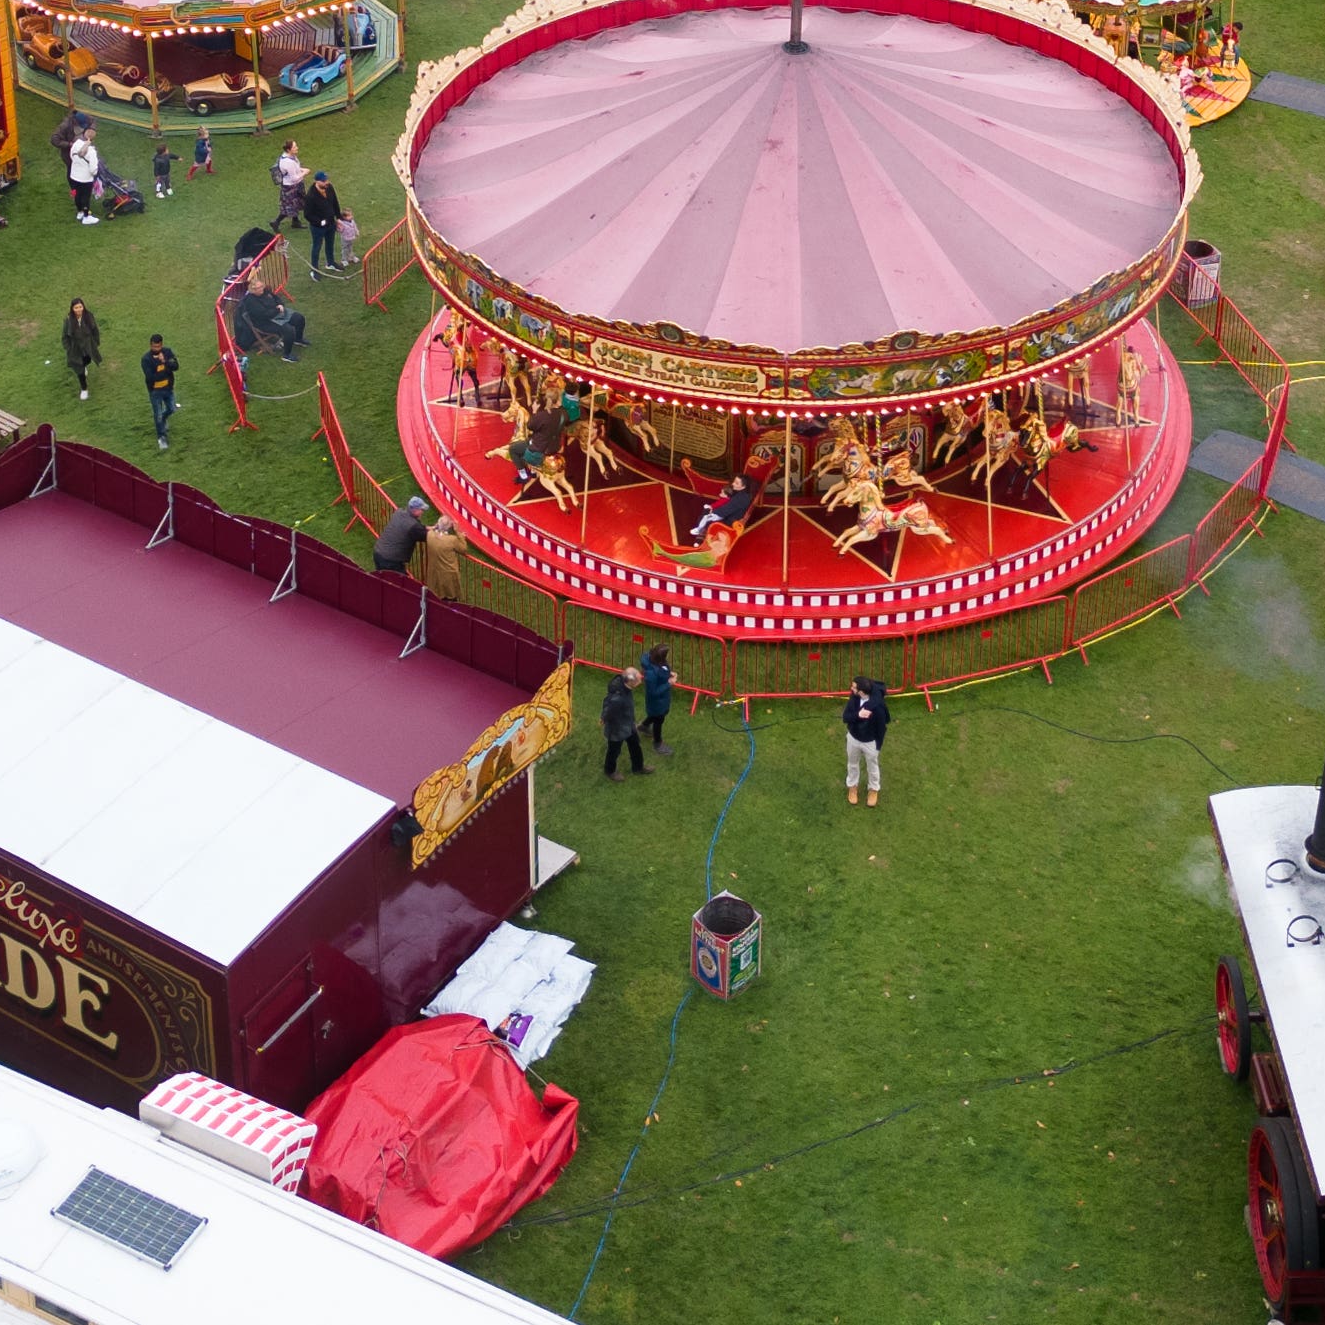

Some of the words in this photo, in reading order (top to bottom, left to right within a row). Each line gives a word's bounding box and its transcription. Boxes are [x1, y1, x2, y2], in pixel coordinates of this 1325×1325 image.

[595, 341, 654, 370] JOHN
[644, 367, 687, 385] STEAM
[689, 376, 760, 394] GALLOPERS
[86, 938, 185, 1054] AMUSEMENTS
